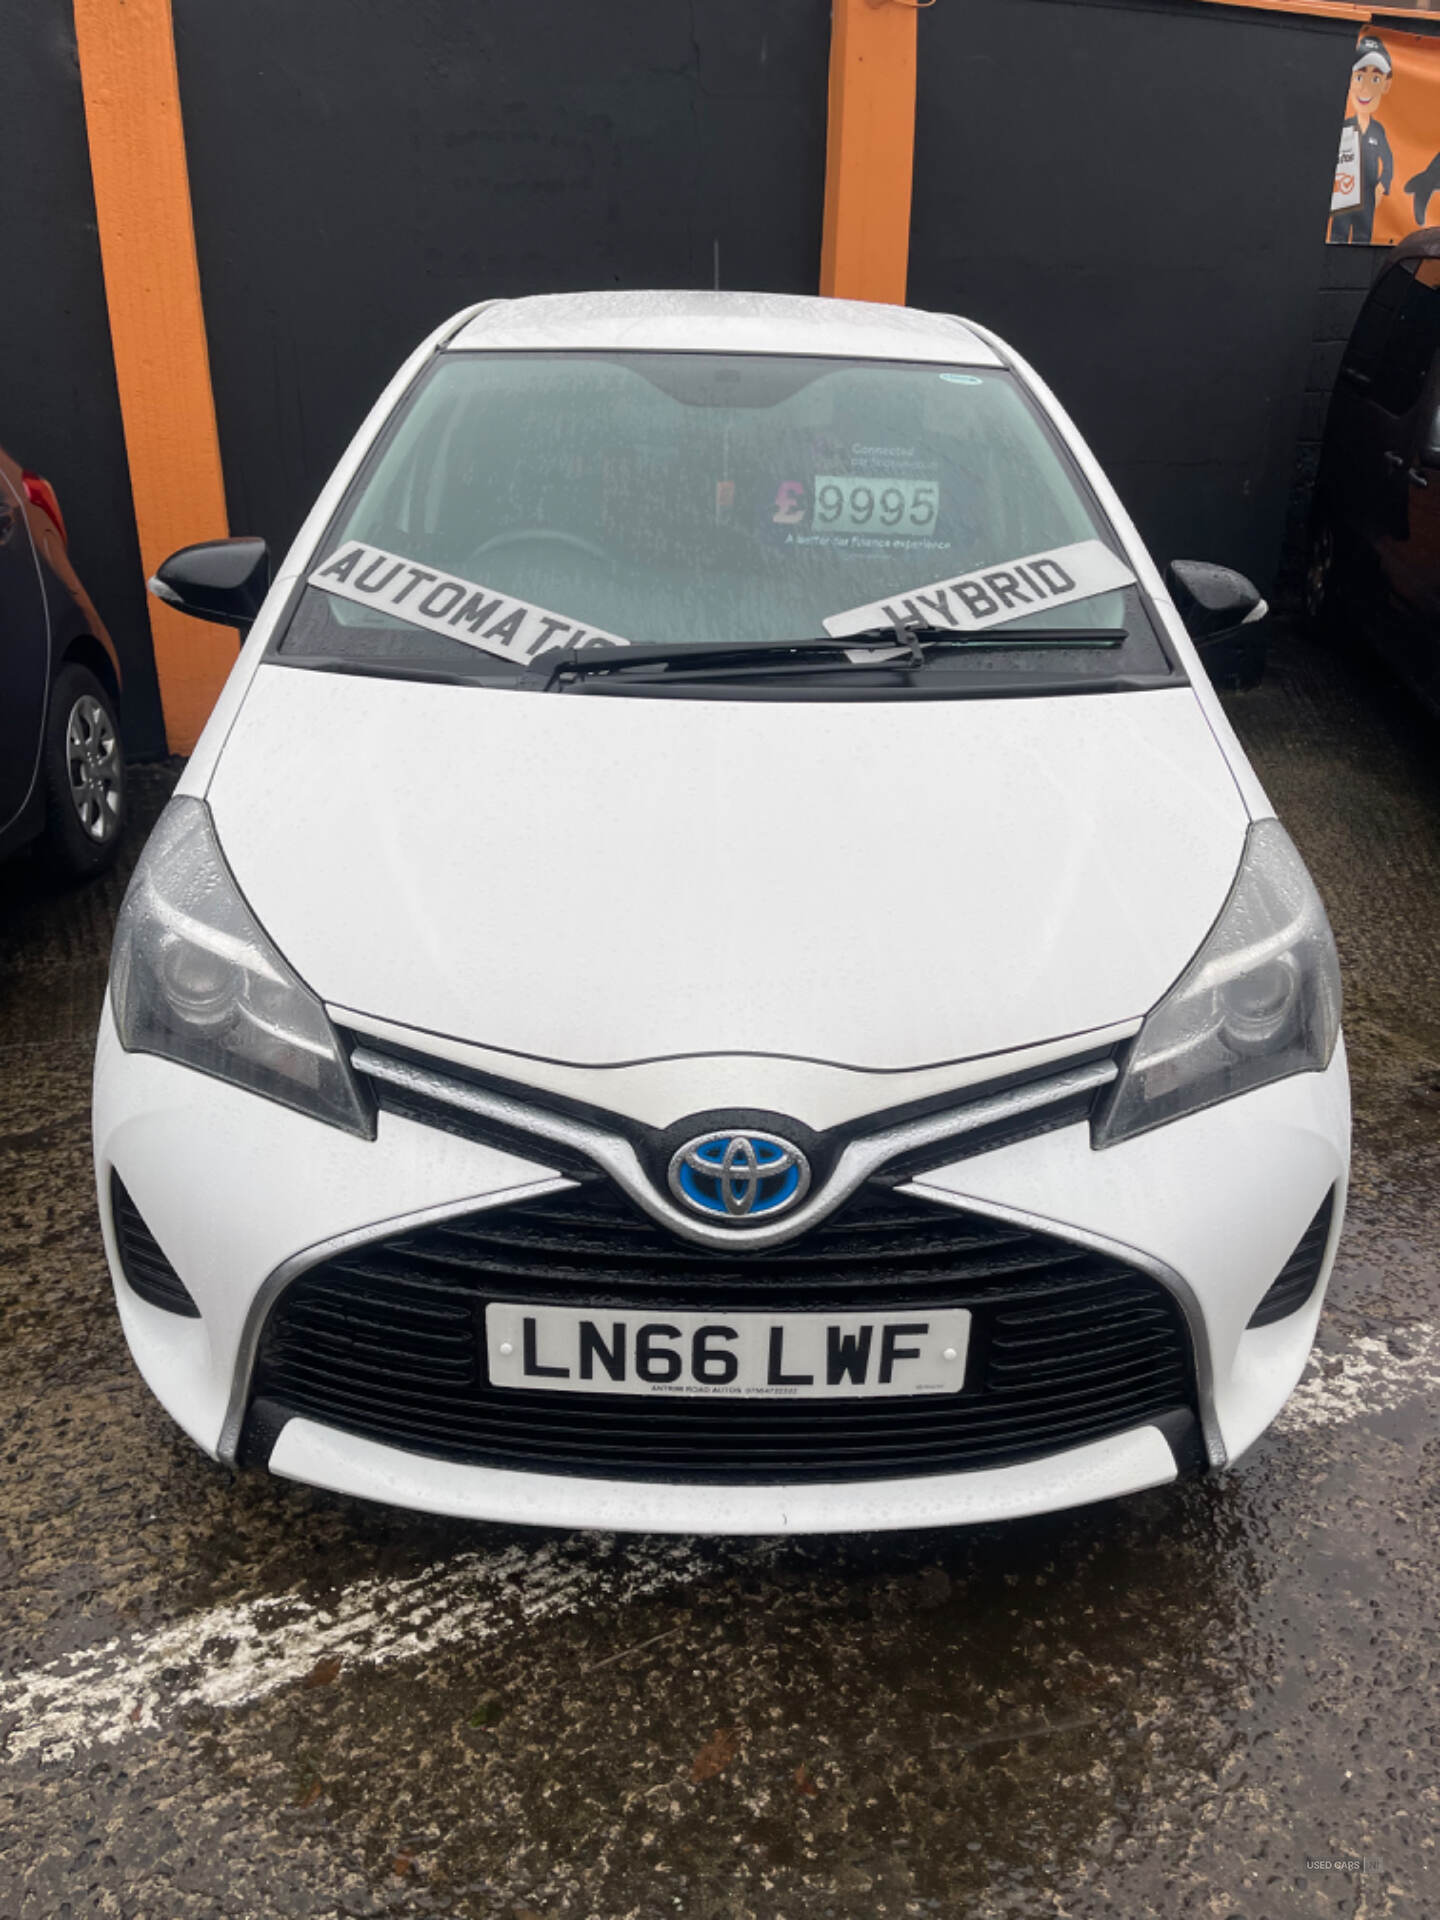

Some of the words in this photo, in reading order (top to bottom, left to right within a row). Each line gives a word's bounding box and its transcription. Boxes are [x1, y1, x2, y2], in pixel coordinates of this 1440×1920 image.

[818, 484, 935, 526] 9995
[881, 558, 1076, 629] HYBRID
[523, 1317, 740, 1384] LN66
[767, 1323, 929, 1385] LWF
